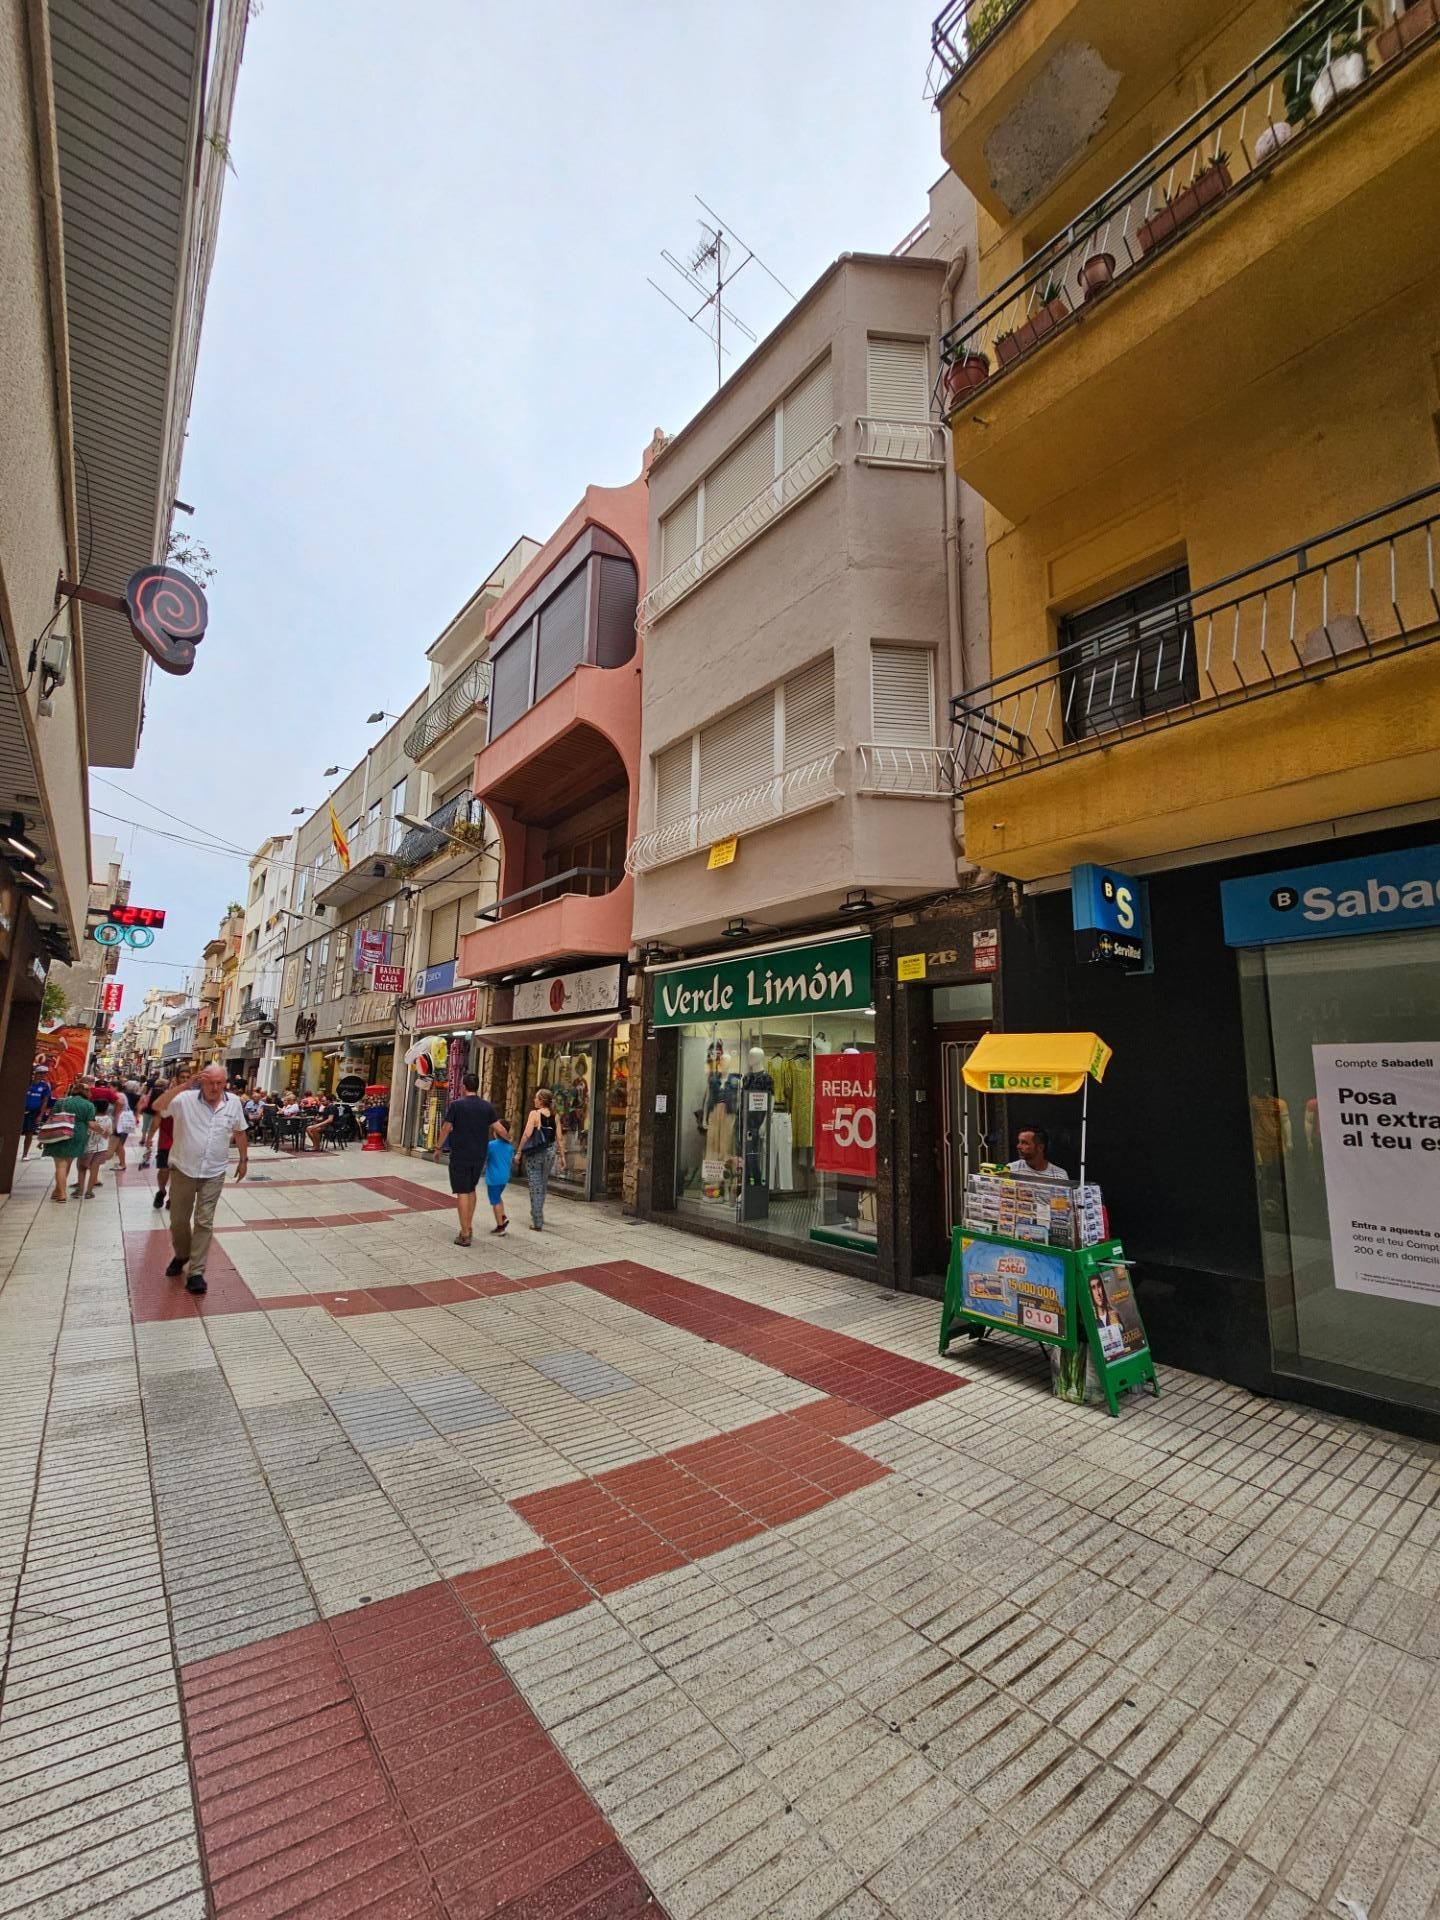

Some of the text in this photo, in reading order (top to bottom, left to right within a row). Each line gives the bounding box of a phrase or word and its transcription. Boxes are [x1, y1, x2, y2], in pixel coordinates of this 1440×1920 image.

[1104, 882, 1113, 898] B
[1116, 887, 1134, 929] S
[1277, 878, 1440, 922] B Saba
[380, 975, 398, 983] CASA
[662, 973, 734, 1018] Verde
[747, 962, 853, 1006] Limón
[1335, 1058, 1433, 1069] Compte Sabadell
[822, 1080, 876, 1097] REBAJ
[1007, 1076, 1053, 1088] ONCE
[1338, 1087, 1397, 1105] Posa
[1340, 1111, 1440, 1129] un extra
[1343, 1131, 1363, 1147] al
[1371, 1132, 1412, 1150] teu
[1351, 1220, 1377, 1231] Entra
[1389, 1226, 1431, 1238] aquesta
[1353, 1233, 1440, 1252] obre el teu Compt
[1353, 1245, 1374, 1256] 200
[1377, 1249, 1384, 1257] €
[1386, 1251, 1398, 1259] en
[997, 1258, 1026, 1275] Estiu
